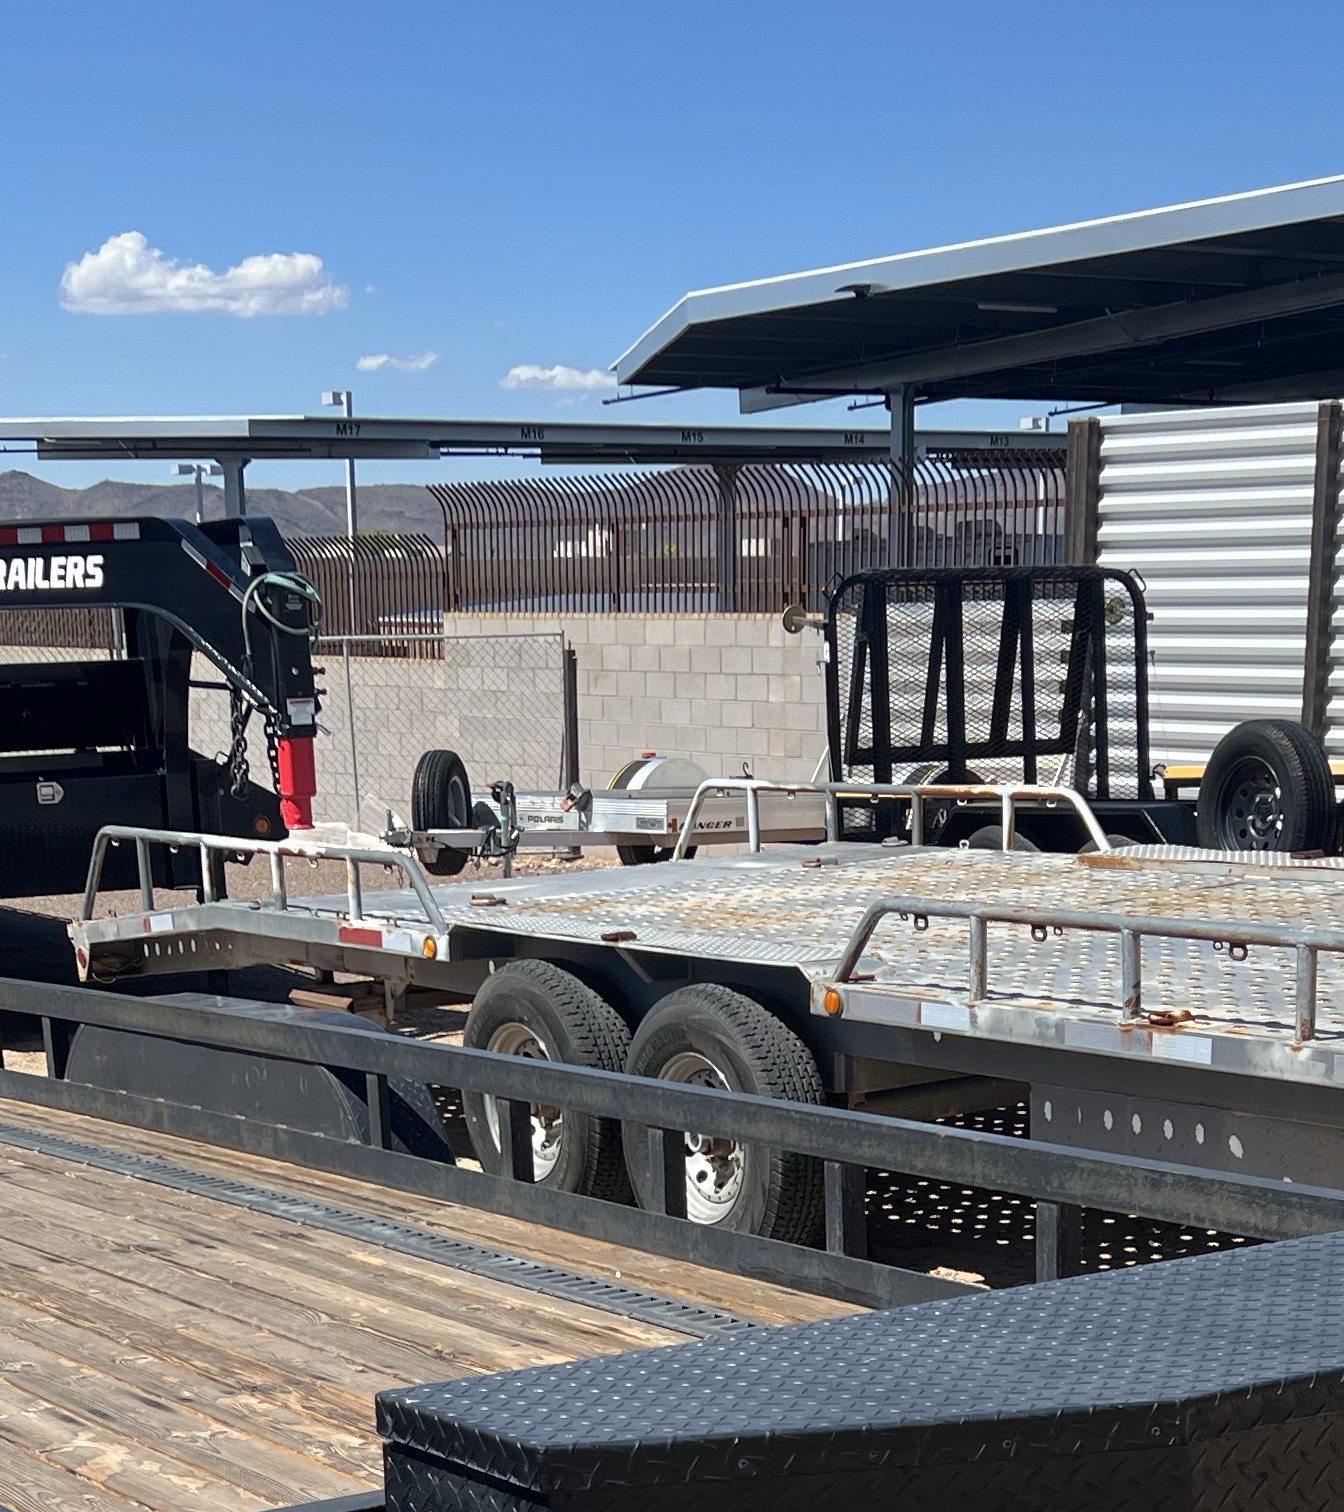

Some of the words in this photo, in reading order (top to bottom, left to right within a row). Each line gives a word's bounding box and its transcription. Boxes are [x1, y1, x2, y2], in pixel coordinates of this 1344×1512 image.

[336, 423, 361, 437] M17
[520, 426, 545, 440] M16
[681, 430, 704, 443] M15
[843, 433, 865, 446] M14
[989, 434, 1011, 447] M13
[527, 815, 564, 824] POLARIS
[678, 820, 733, 831] NGER
